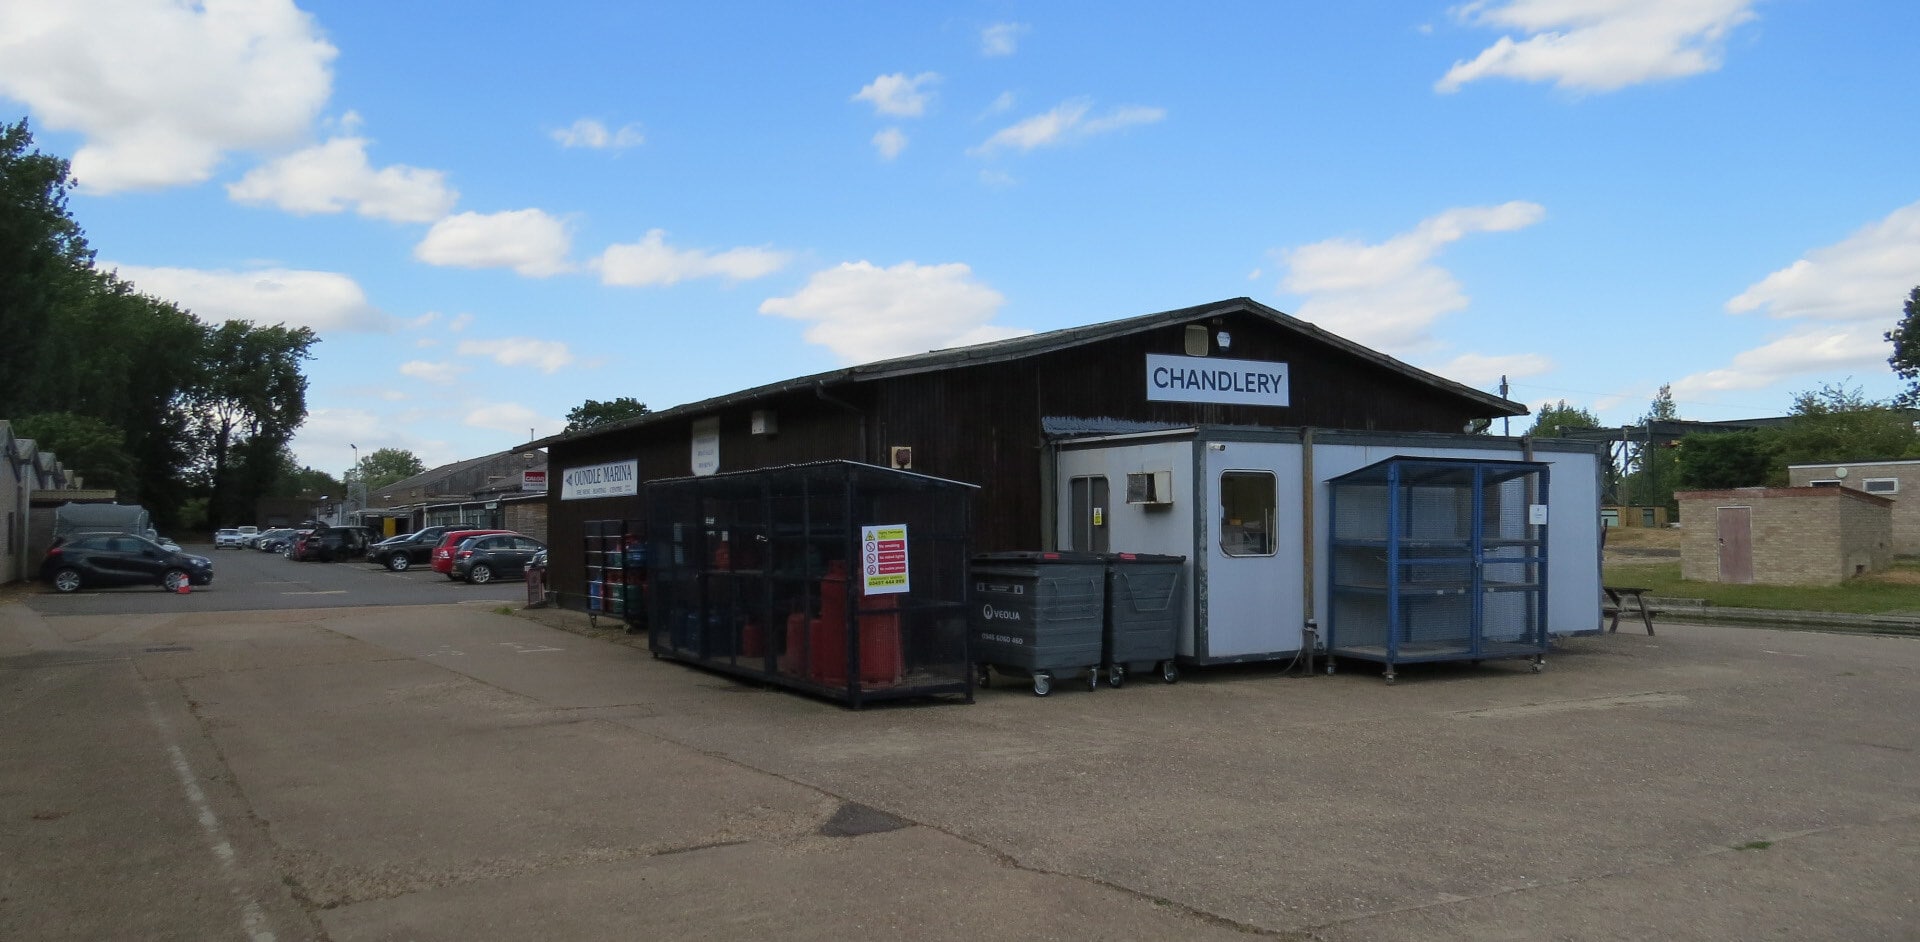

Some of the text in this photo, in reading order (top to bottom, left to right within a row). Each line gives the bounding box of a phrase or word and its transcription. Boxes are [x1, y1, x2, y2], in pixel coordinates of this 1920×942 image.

[1153, 366, 1282, 394] CHANDLERY
[574, 464, 632, 486] OUNDLE MARINA
[993, 610, 1020, 620] VEOLIA
